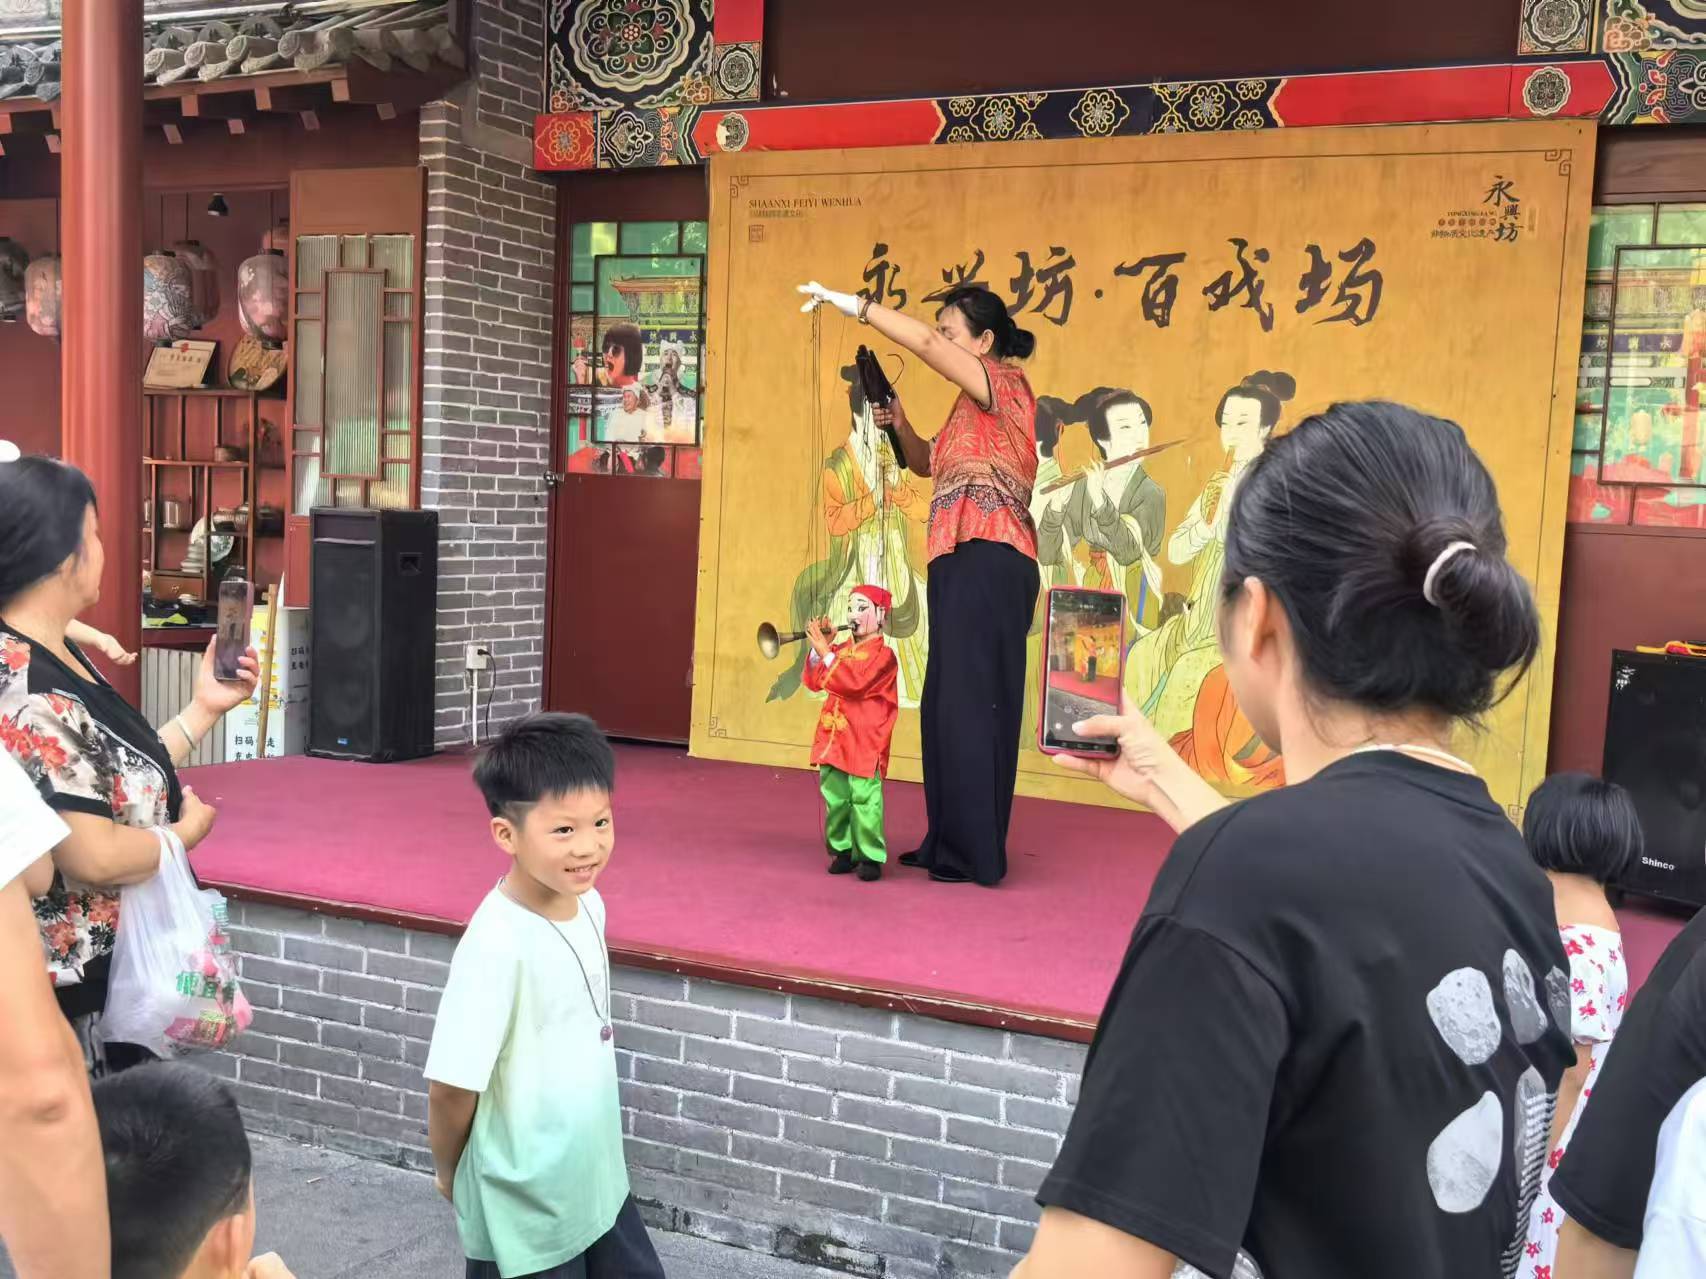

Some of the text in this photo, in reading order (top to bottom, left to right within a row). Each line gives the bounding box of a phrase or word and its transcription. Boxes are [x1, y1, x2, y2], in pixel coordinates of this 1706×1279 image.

[235, 734, 275, 748] 扫码走
[1641, 856, 1675, 871] Shinco
